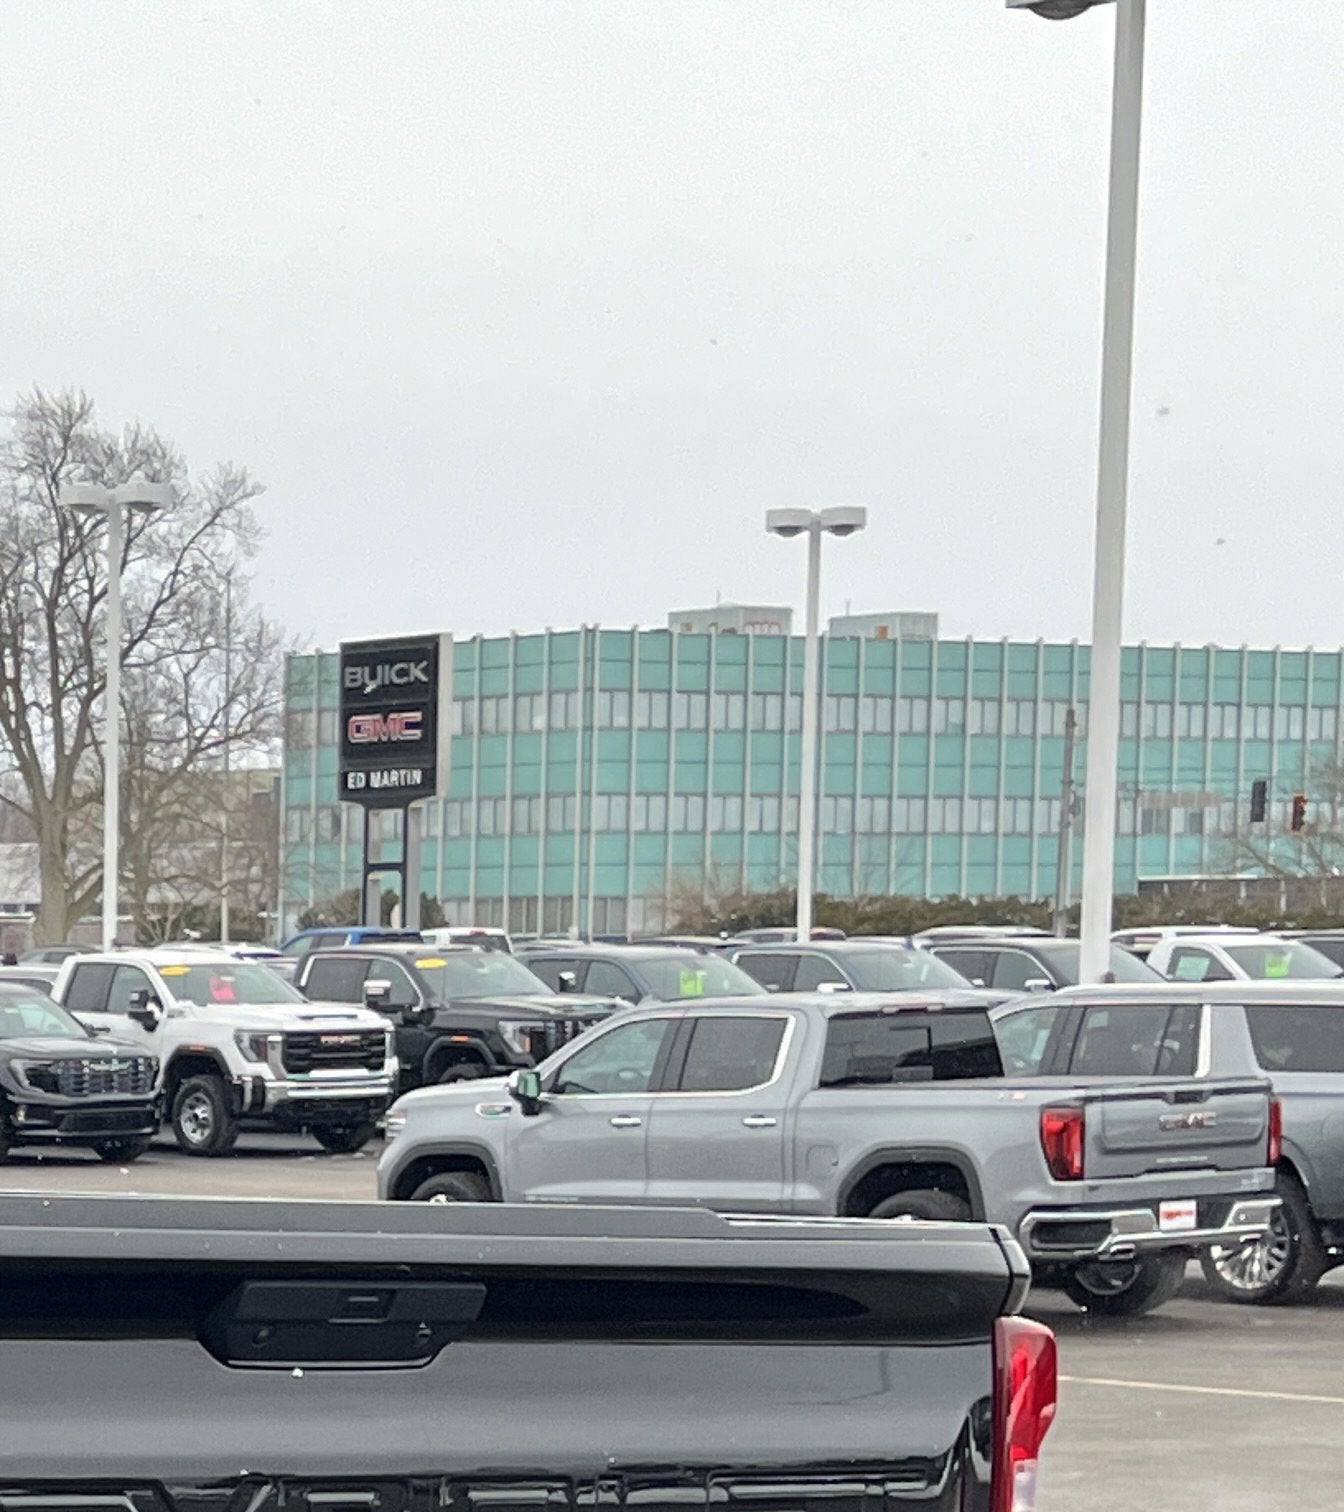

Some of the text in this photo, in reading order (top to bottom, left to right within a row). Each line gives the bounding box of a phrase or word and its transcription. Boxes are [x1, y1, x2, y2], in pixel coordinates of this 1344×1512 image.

[343, 660, 430, 690] BUICK
[347, 710, 424, 744] GMC
[346, 768, 423, 790] ED MARTIN
